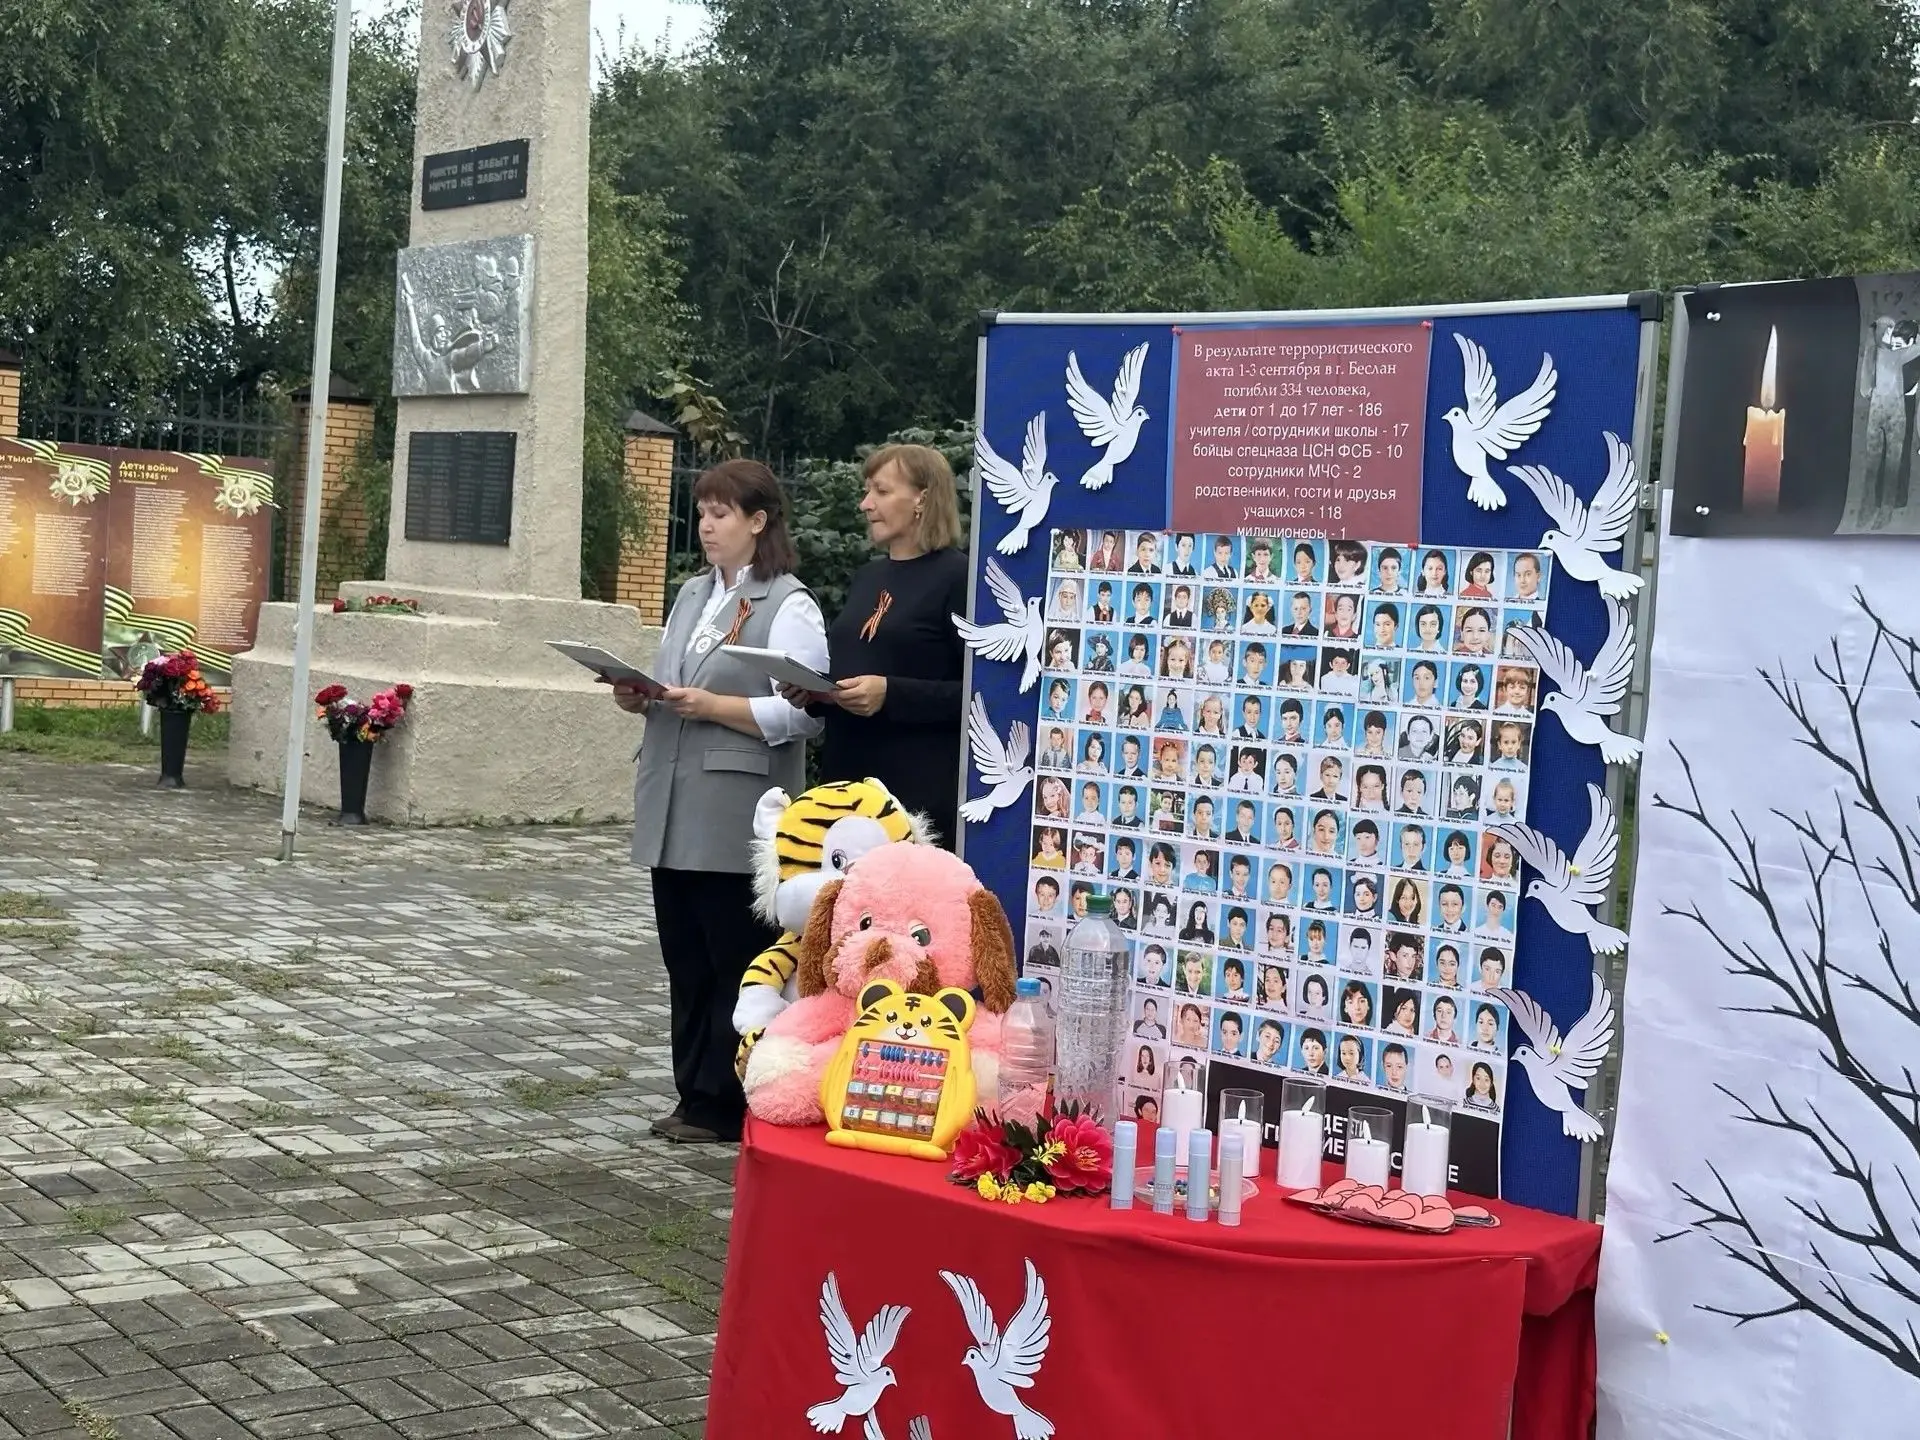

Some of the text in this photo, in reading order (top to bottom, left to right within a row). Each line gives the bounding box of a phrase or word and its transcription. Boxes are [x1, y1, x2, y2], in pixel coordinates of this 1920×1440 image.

[461, 162, 474, 174] НЕ
[460, 176, 473, 188] НЕ
[1193, 343, 1413, 361] В результате террористического
[1205, 361, 1396, 380] акта 1-3 сентября в г. Беслан
[1224, 382, 1371, 398] погибли 334 человека,
[1214, 407, 1247, 418] дети
[1250, 406, 1264, 417] от
[1269, 403, 1275, 417] 1
[1280, 405, 1297, 418] до
[1302, 403, 1318, 417] 17
[1321, 405, 1344, 417] лет
[1358, 402, 1383, 417] 186
[1189, 425, 1241, 440] учителя
[1334, 426, 1378, 437] школы
[1392, 423, 1409, 437] 17
[1193, 442, 1233, 459] бойцы
[1237, 446, 1298, 459] спецназа
[1302, 443, 1334, 459] ЦСН
[1338, 443, 1372, 458] ФСБ
[1386, 444, 1403, 458] 10
[119, 460, 179, 474] Дети войны
[1228, 466, 1304, 480] сотрудники
[1308, 463, 1341, 479] МЧС
[1352, 465, 1362, 479] 2
[1195, 485, 1396, 503] родственники, гости и друзья
[1243, 506, 1305, 520] учащихся
[1319, 505, 1342, 520] 118
[1236, 526, 1327, 539] милиционеры
[1340, 526, 1346, 540] 1
